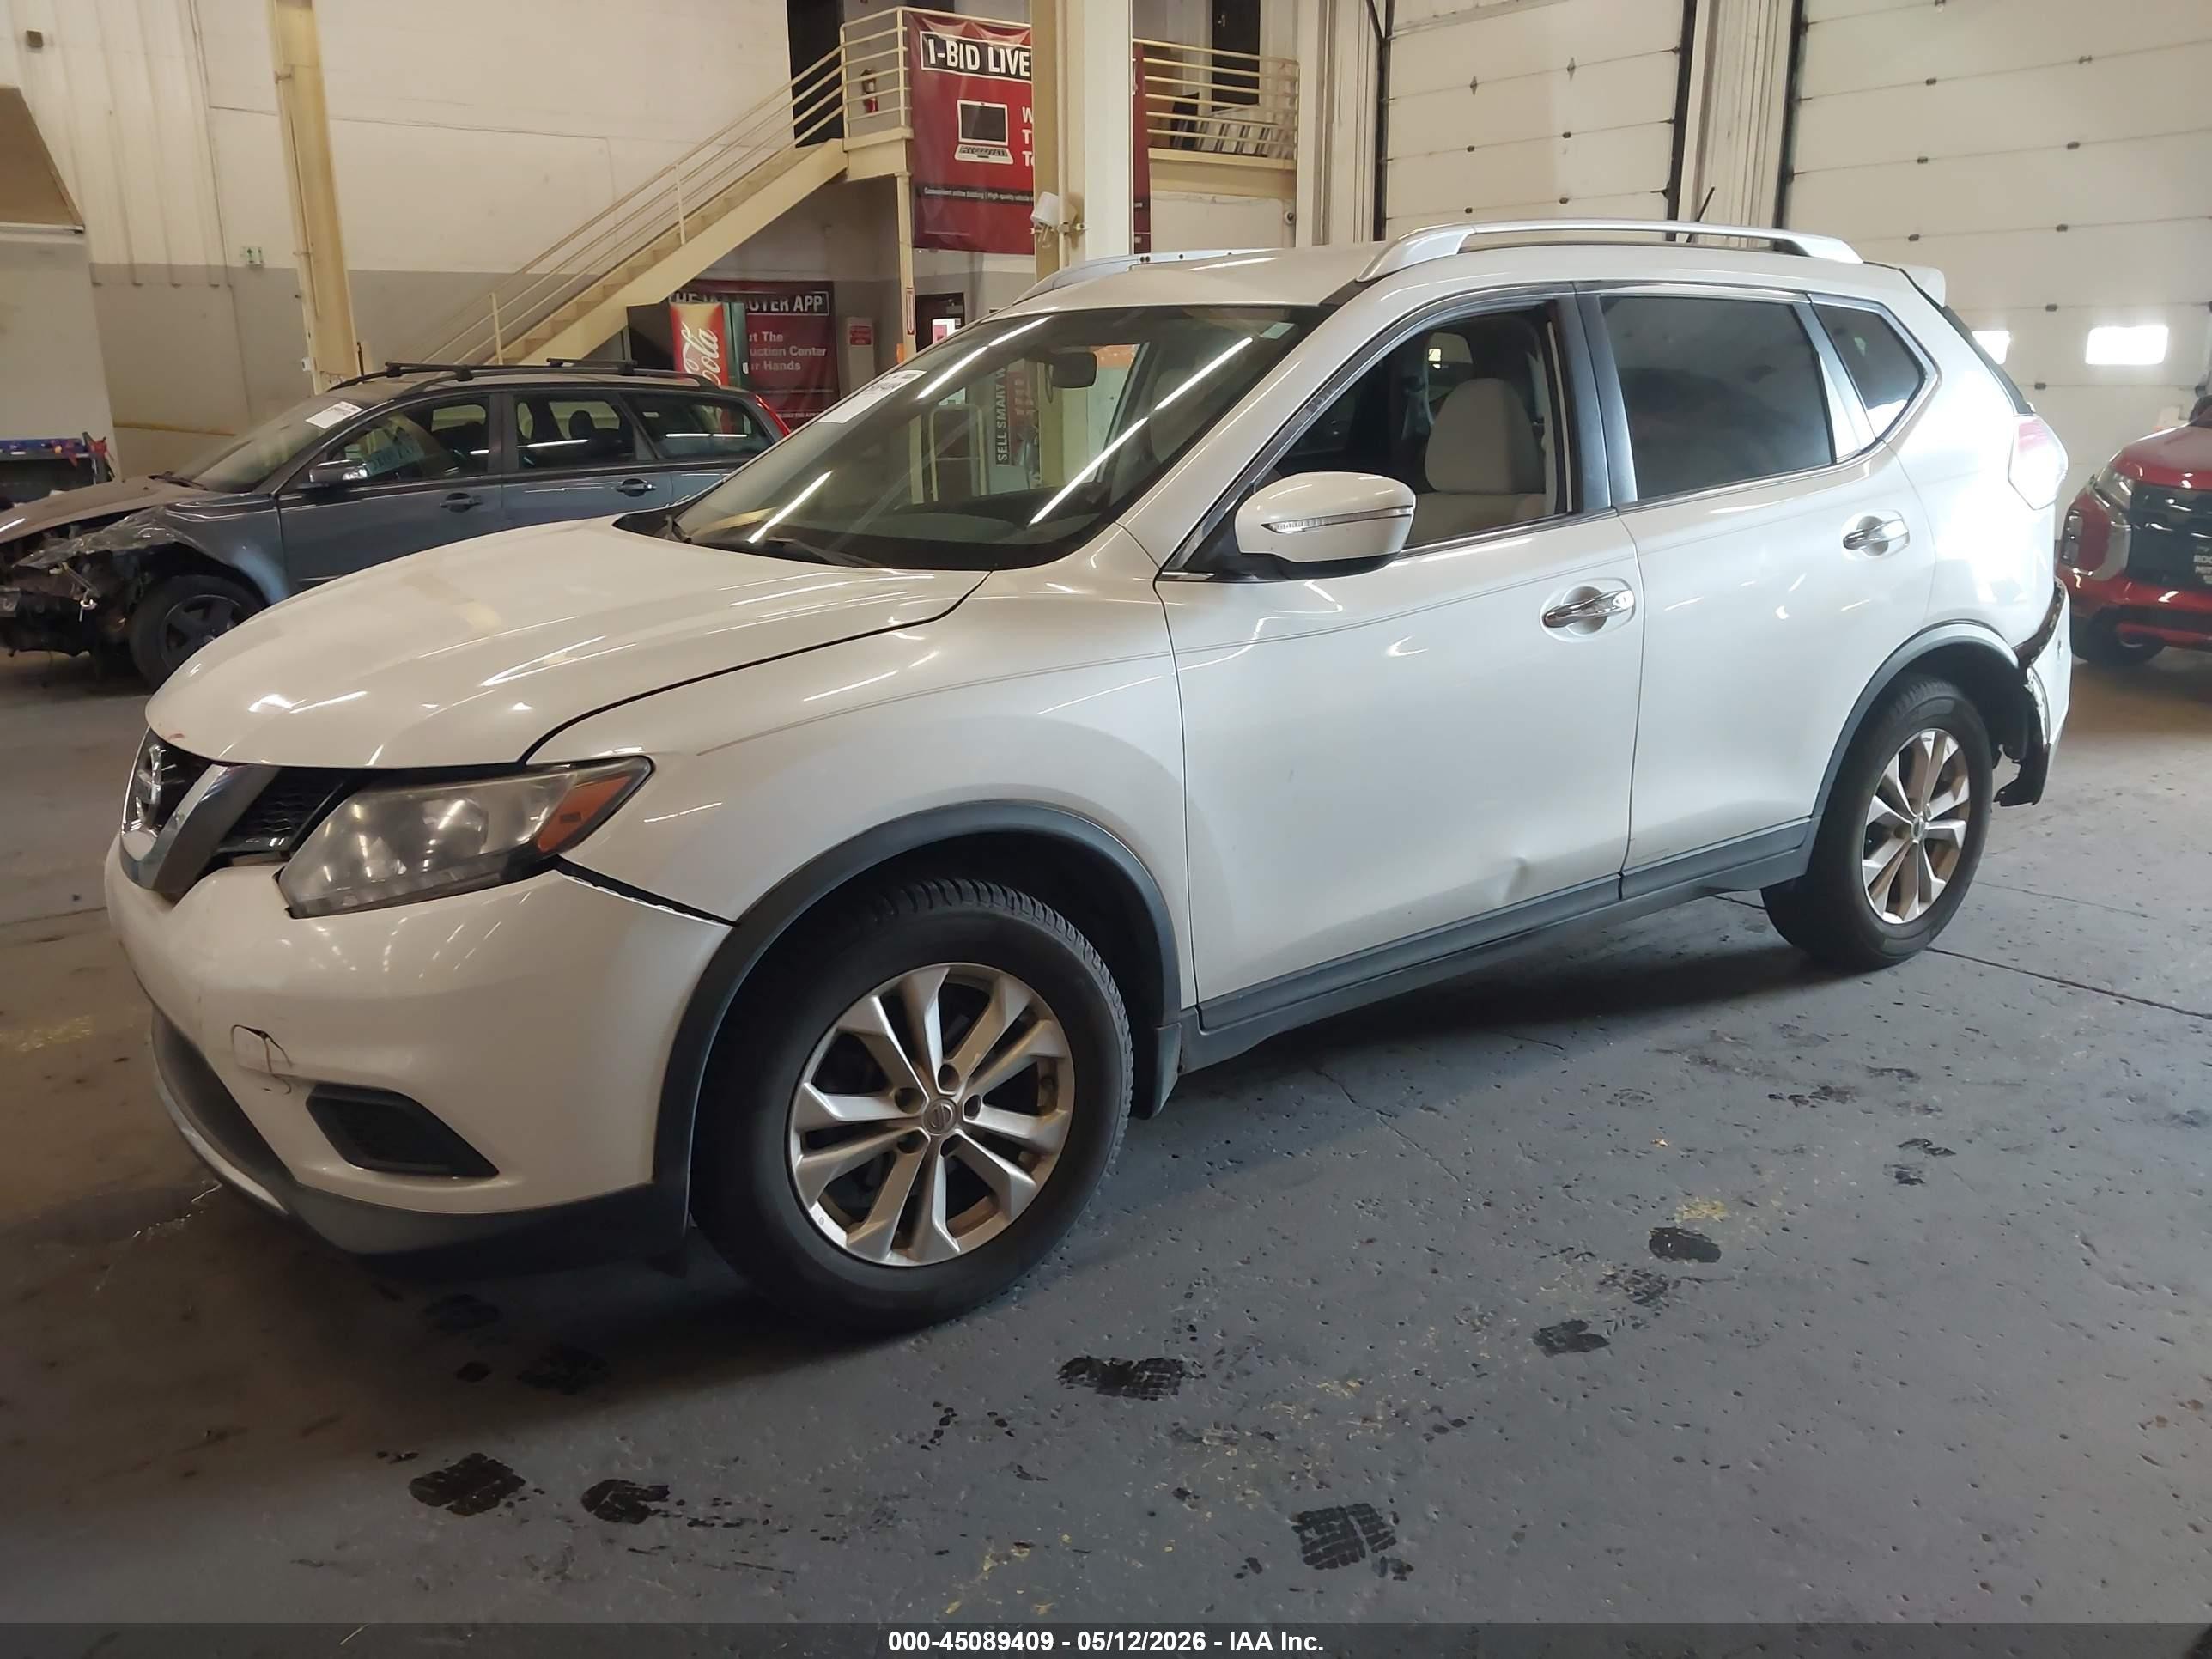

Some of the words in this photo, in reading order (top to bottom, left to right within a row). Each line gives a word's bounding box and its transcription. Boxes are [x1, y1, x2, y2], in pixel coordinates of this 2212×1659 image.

[927, 38, 981, 70] I-BID
[988, 46, 1030, 77] LIVE
[793, 295, 823, 312] APP
[762, 331, 784, 342] The
[749, 345, 787, 356] uction
[789, 346, 827, 356] Center
[763, 360, 801, 371] Hands
[997, 432, 1008, 462] SELL
